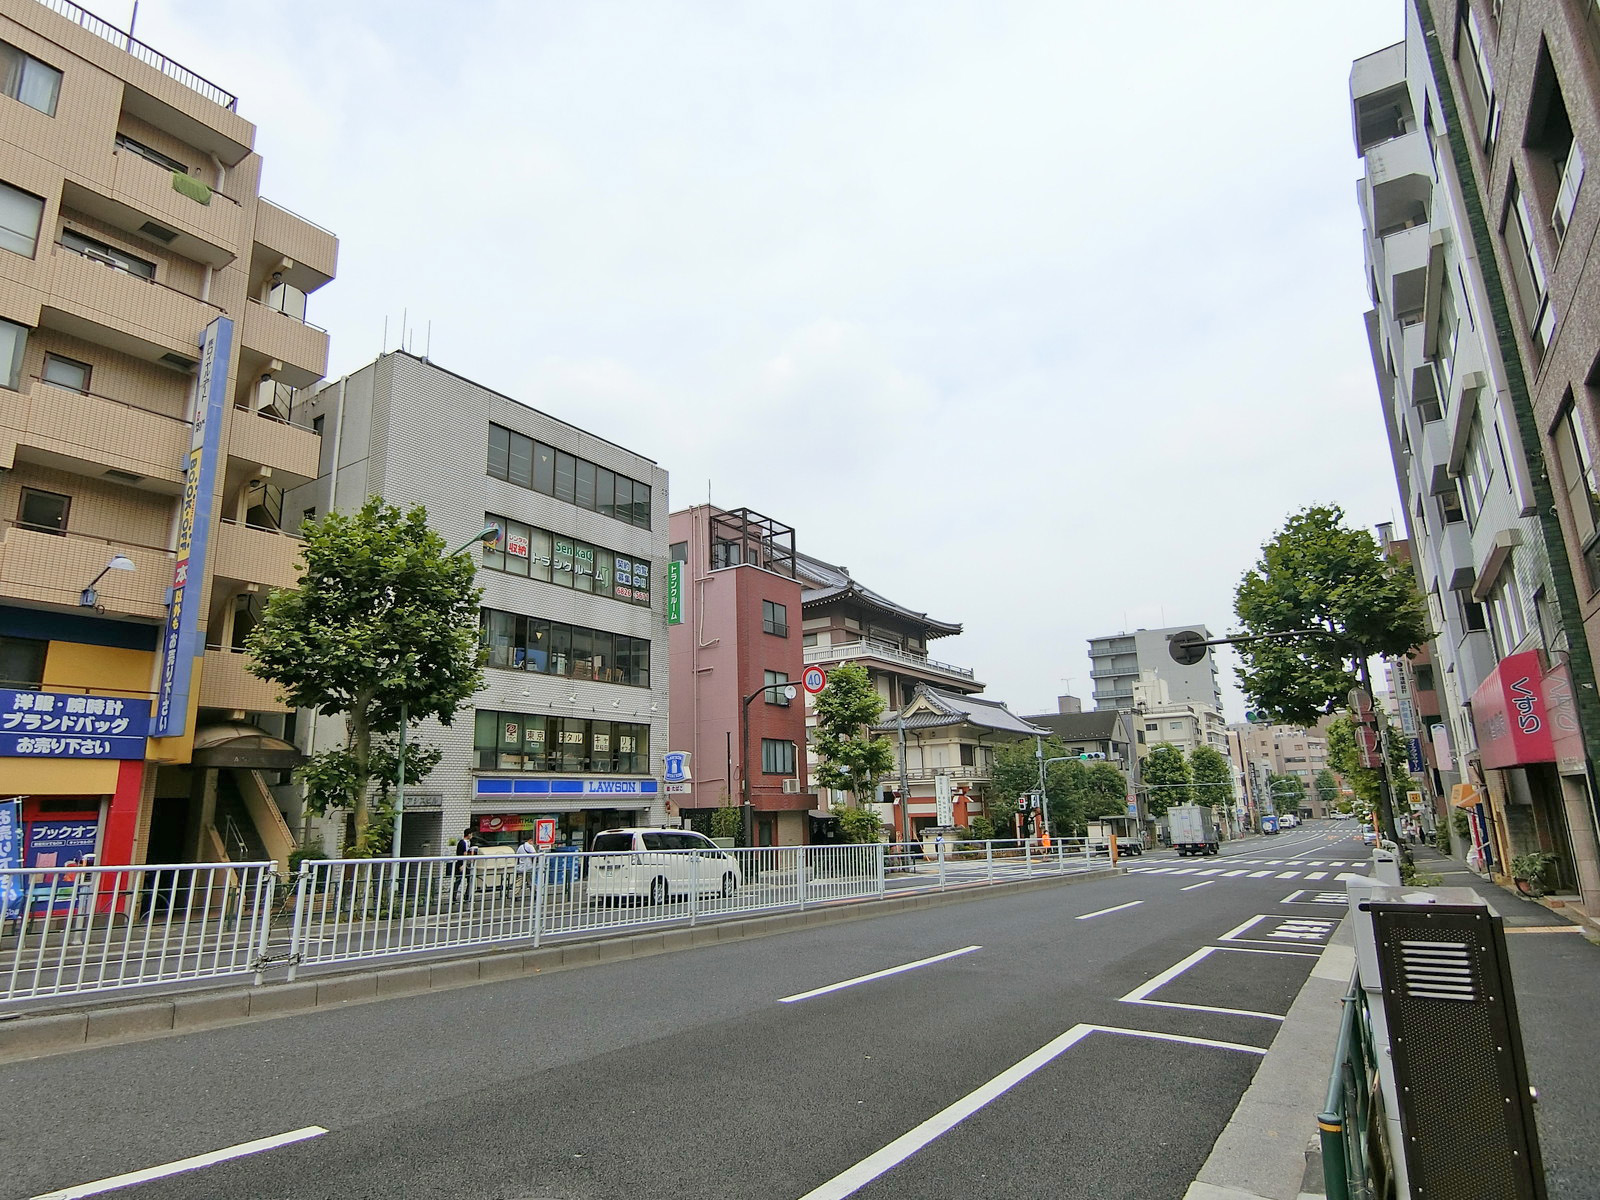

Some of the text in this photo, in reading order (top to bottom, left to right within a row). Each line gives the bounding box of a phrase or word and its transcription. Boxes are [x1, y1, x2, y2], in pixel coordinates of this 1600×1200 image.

[508, 542, 527, 556] 収納
[175, 563, 188, 584] 本
[532, 552, 604, 582] トランクルーム
[670, 565, 678, 620] トランクルーム
[158, 632, 178, 734] お売り下さい
[807, 673, 821, 686] 40
[13, 693, 124, 716] 洋服・腕時計
[1510, 676, 1541, 735] くすり
[3, 711, 130, 734] ブランドバッグ
[16, 736, 111, 755] お売り下さい
[527, 731, 544, 740] 東京
[588, 781, 636, 793] LAWSON
[32, 825, 98, 840] ブックオフ
